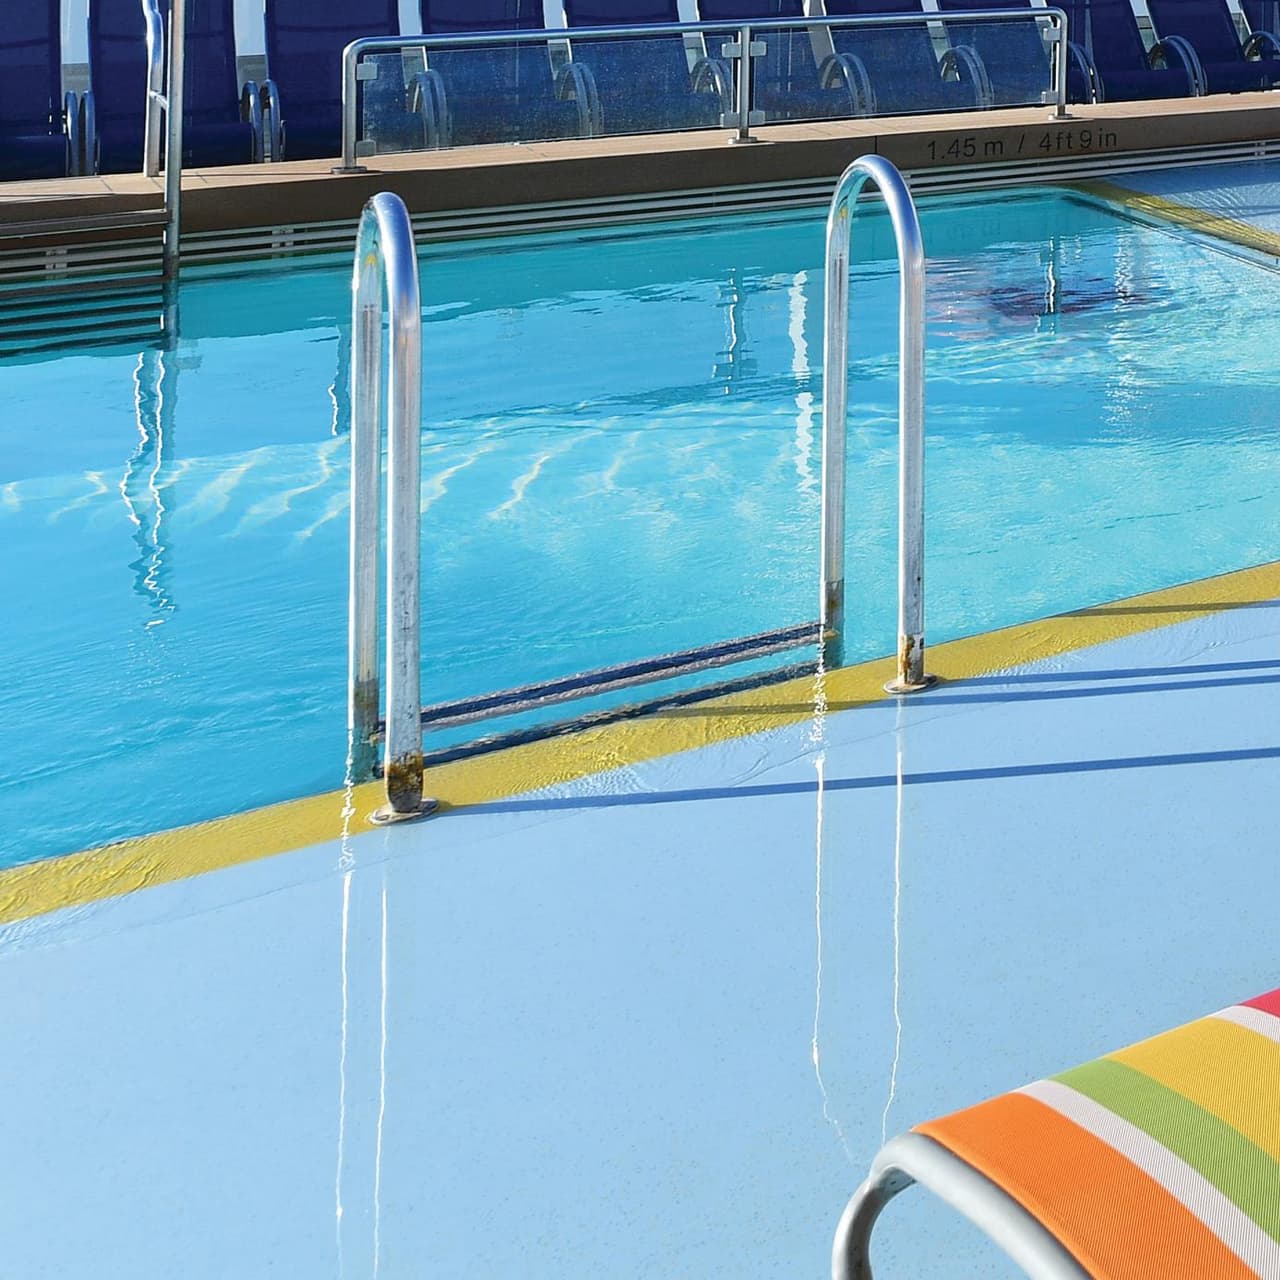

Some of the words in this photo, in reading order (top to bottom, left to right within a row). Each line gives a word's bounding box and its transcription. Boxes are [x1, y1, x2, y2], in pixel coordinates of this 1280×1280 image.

[927, 137, 976, 160] 1.45
[984, 140, 1004, 156] m
[1018, 134, 1025, 153] /
[1080, 129, 1092, 148] 9
[1098, 128, 1117, 147] in
